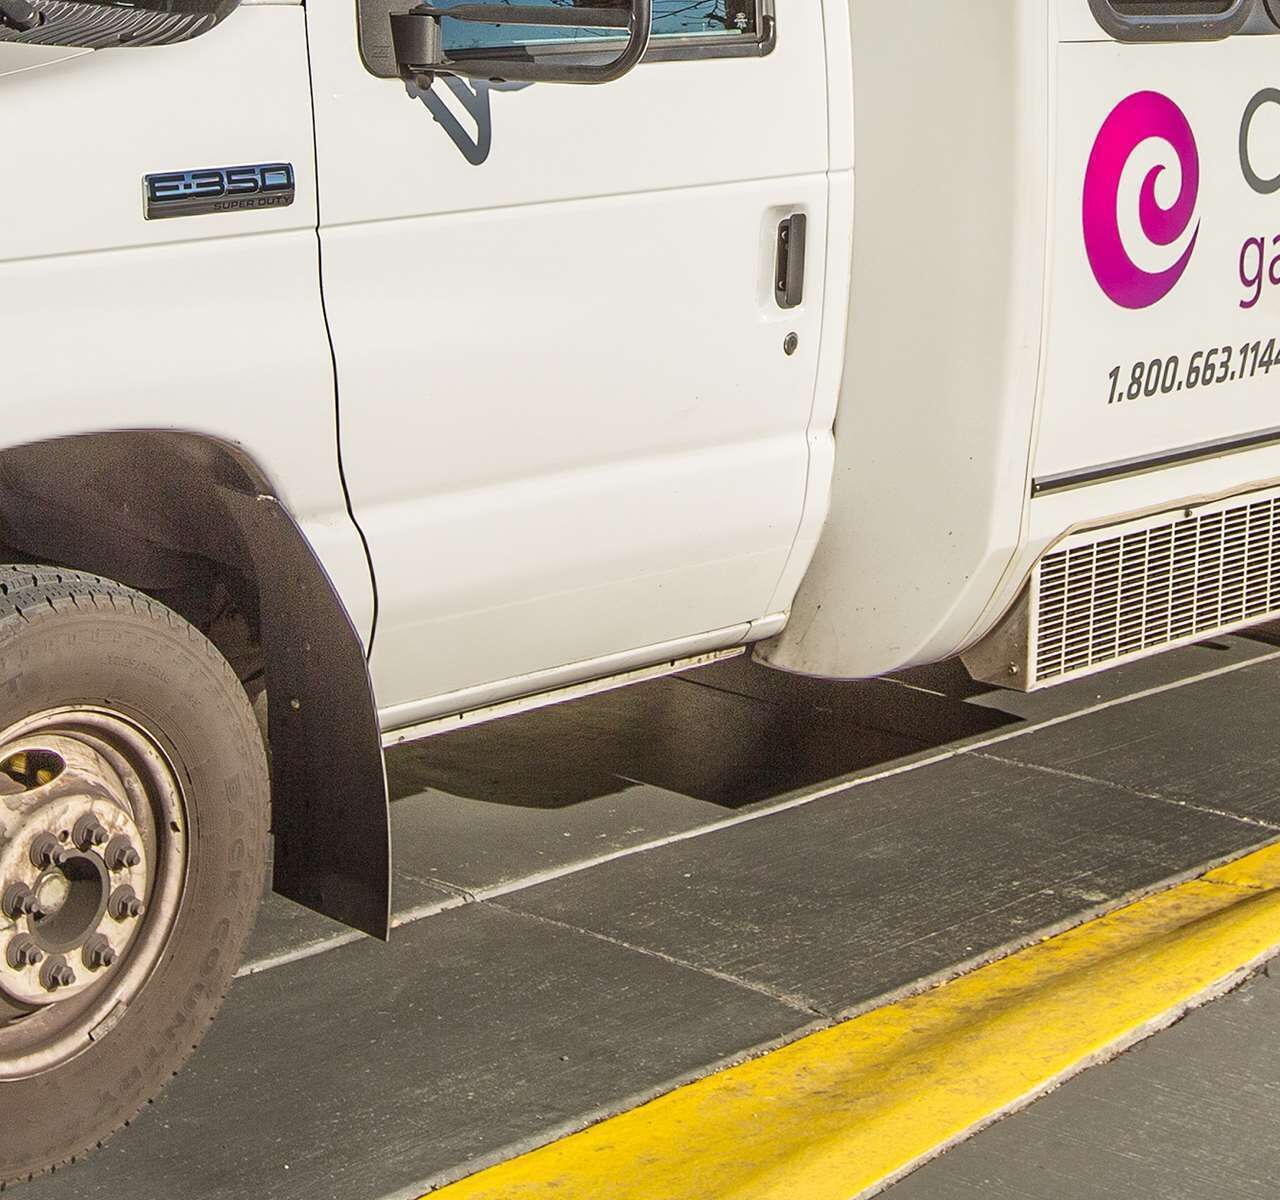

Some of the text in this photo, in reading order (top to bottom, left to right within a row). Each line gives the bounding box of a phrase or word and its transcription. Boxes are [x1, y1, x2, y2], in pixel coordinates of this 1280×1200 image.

[148, 166, 290, 202] E-350
[213, 196, 292, 211] SUPER DUTY
